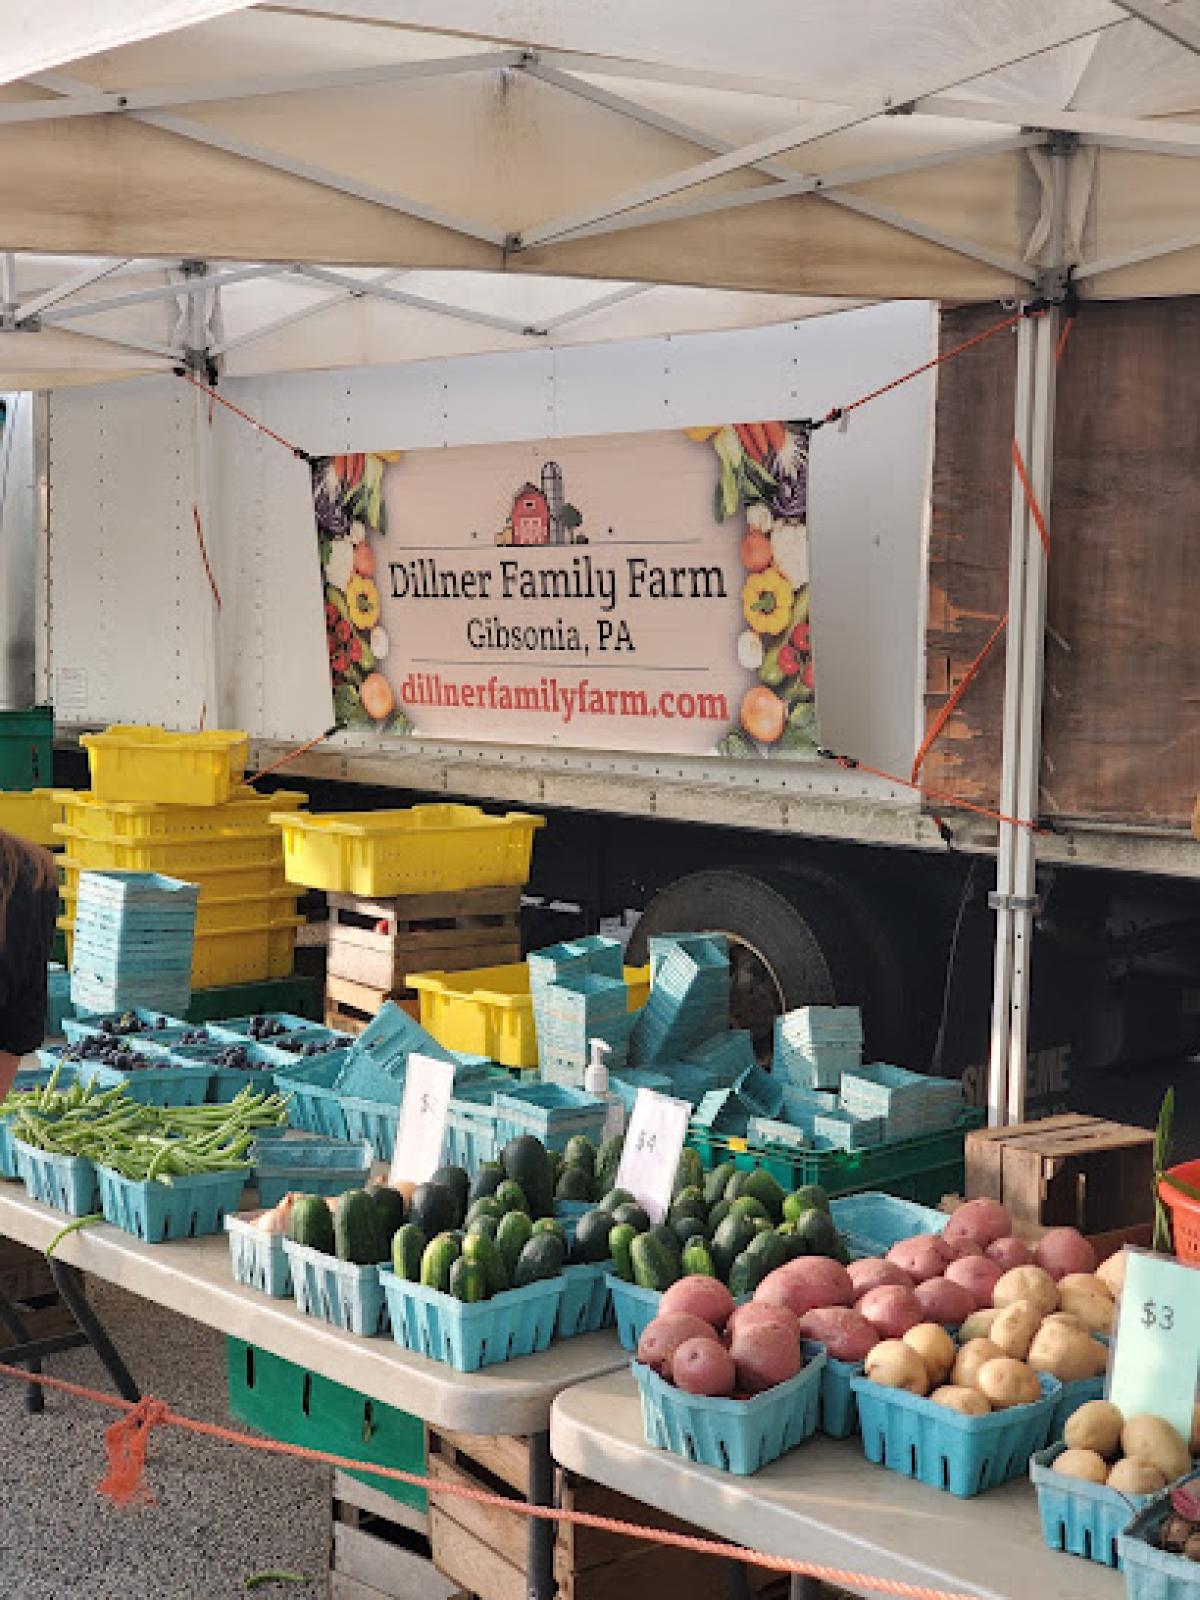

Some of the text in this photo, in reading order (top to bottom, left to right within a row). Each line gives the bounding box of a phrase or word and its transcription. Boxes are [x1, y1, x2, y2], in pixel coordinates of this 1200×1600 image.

[389, 556, 729, 611] Dillner Family Farm
[467, 615, 636, 656] Gibsonia, PA
[401, 673, 729, 723] dillnerfamilyfarm.com
[1141, 1300, 1174, 1330] $3
